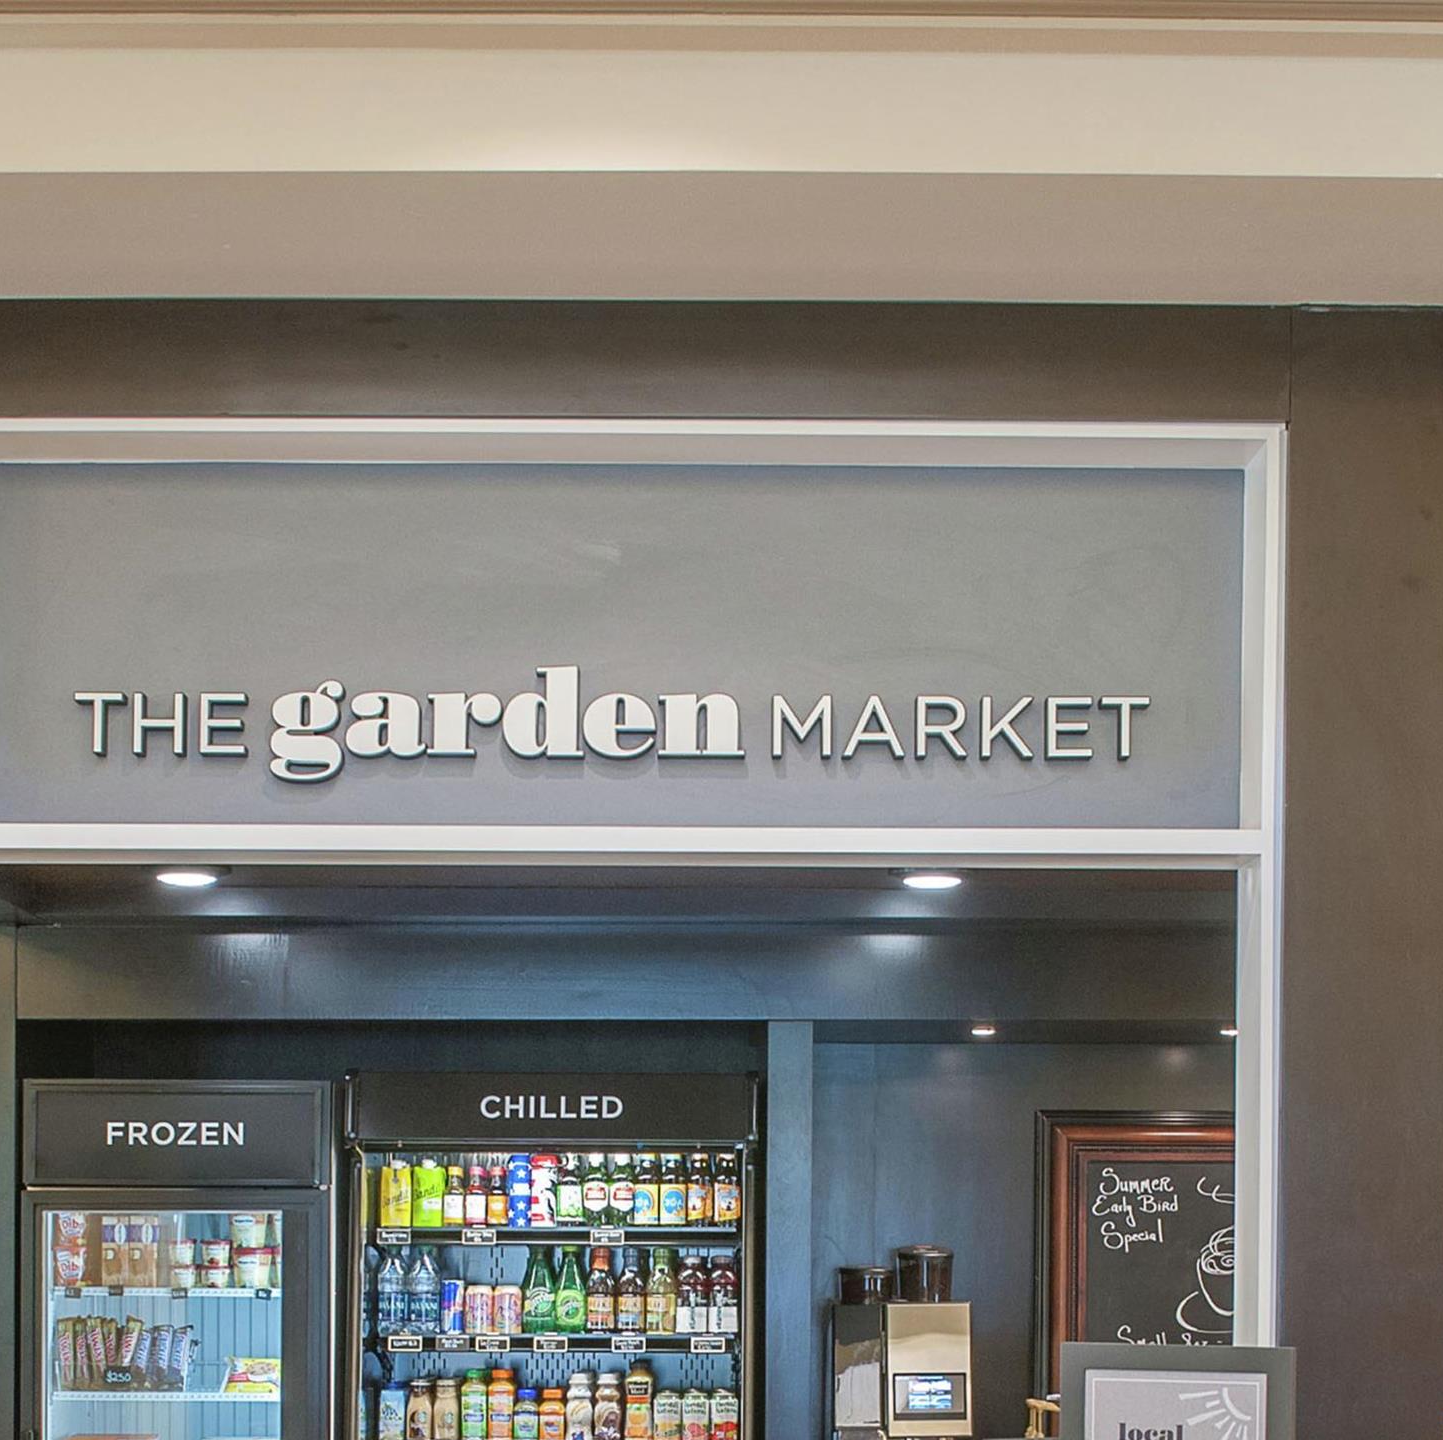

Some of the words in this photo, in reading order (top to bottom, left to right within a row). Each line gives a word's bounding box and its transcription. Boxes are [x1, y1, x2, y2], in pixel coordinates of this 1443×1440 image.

[74, 692, 249, 757] THE
[268, 664, 745, 783] garden
[770, 694, 1151, 761] MARKET
[479, 1095, 624, 1119] CHILLED
[105, 1121, 245, 1146] FROZEN
[1100, 1218, 1164, 1253] Special
